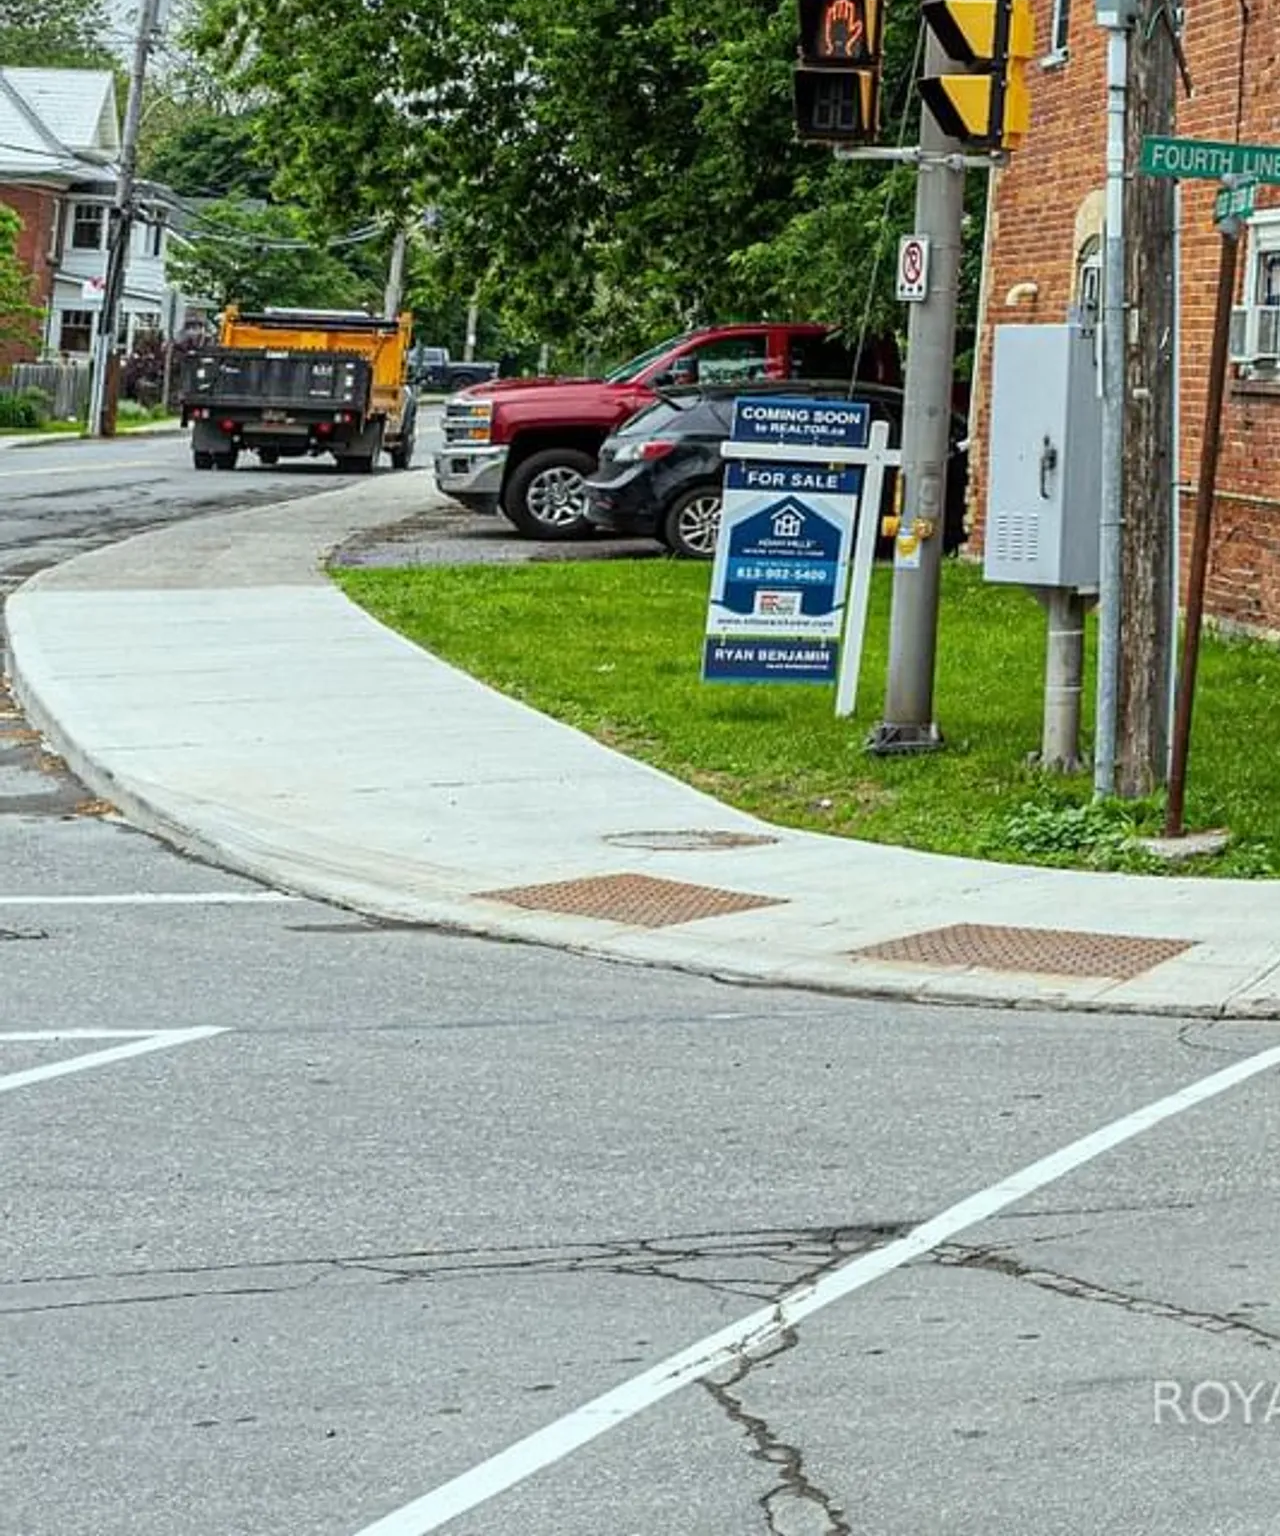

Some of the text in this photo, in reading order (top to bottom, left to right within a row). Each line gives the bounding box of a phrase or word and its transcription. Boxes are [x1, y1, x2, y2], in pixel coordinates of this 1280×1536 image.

[1152, 144, 1234, 174] FOURTH
[742, 406, 861, 424] COMING SOON
[748, 471, 838, 488] FOR SALE
[715, 648, 830, 662] RYAN BENJAMIN
